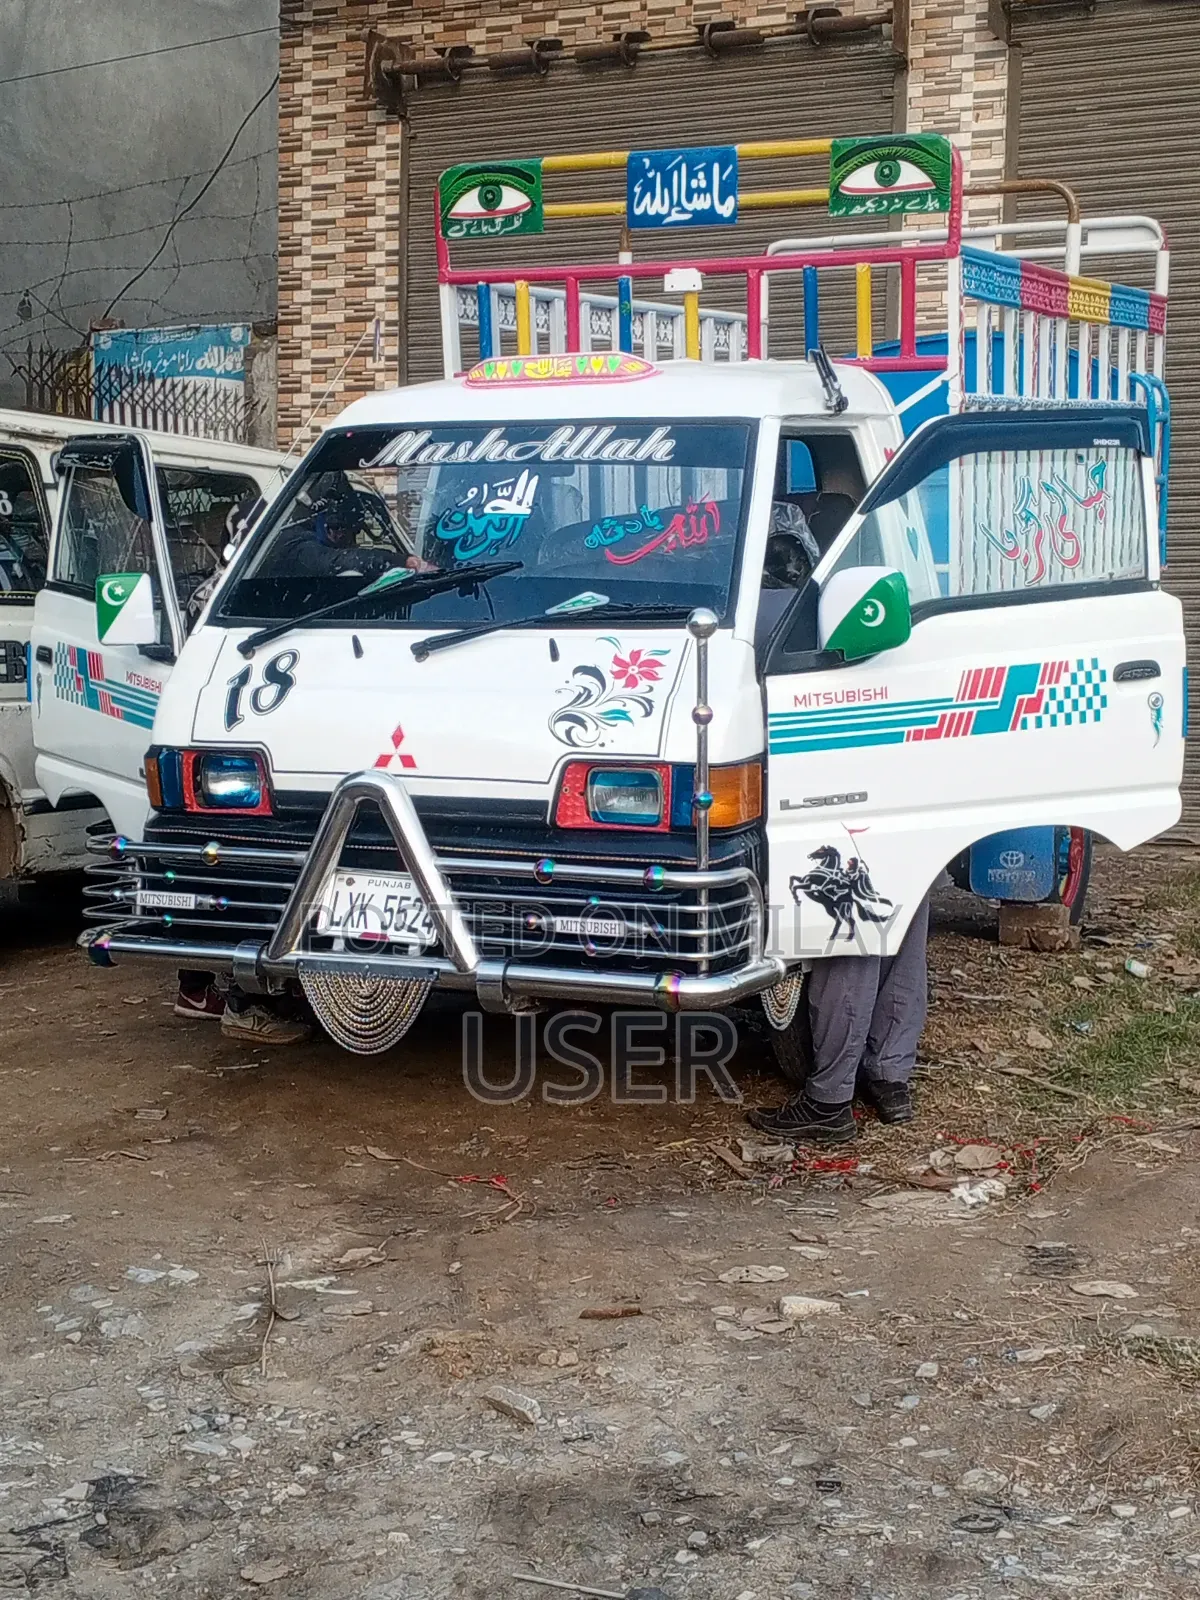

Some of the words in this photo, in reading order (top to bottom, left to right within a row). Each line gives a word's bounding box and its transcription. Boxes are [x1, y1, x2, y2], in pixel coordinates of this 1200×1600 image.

[584, 504, 665, 549] بادشاہ
[125, 669, 163, 694] MITSUBISHI
[224, 648, 301, 733] 18
[793, 687, 889, 708] MITSUBISHI
[779, 791, 868, 811] L300
[367, 879, 412, 890] PUNJAB
[138, 893, 192, 908] MITSUBISHI
[329, 890, 375, 930] LXK
[379, 894, 434, 935] 5524
[559, 919, 622, 936] MITSUBISHI
